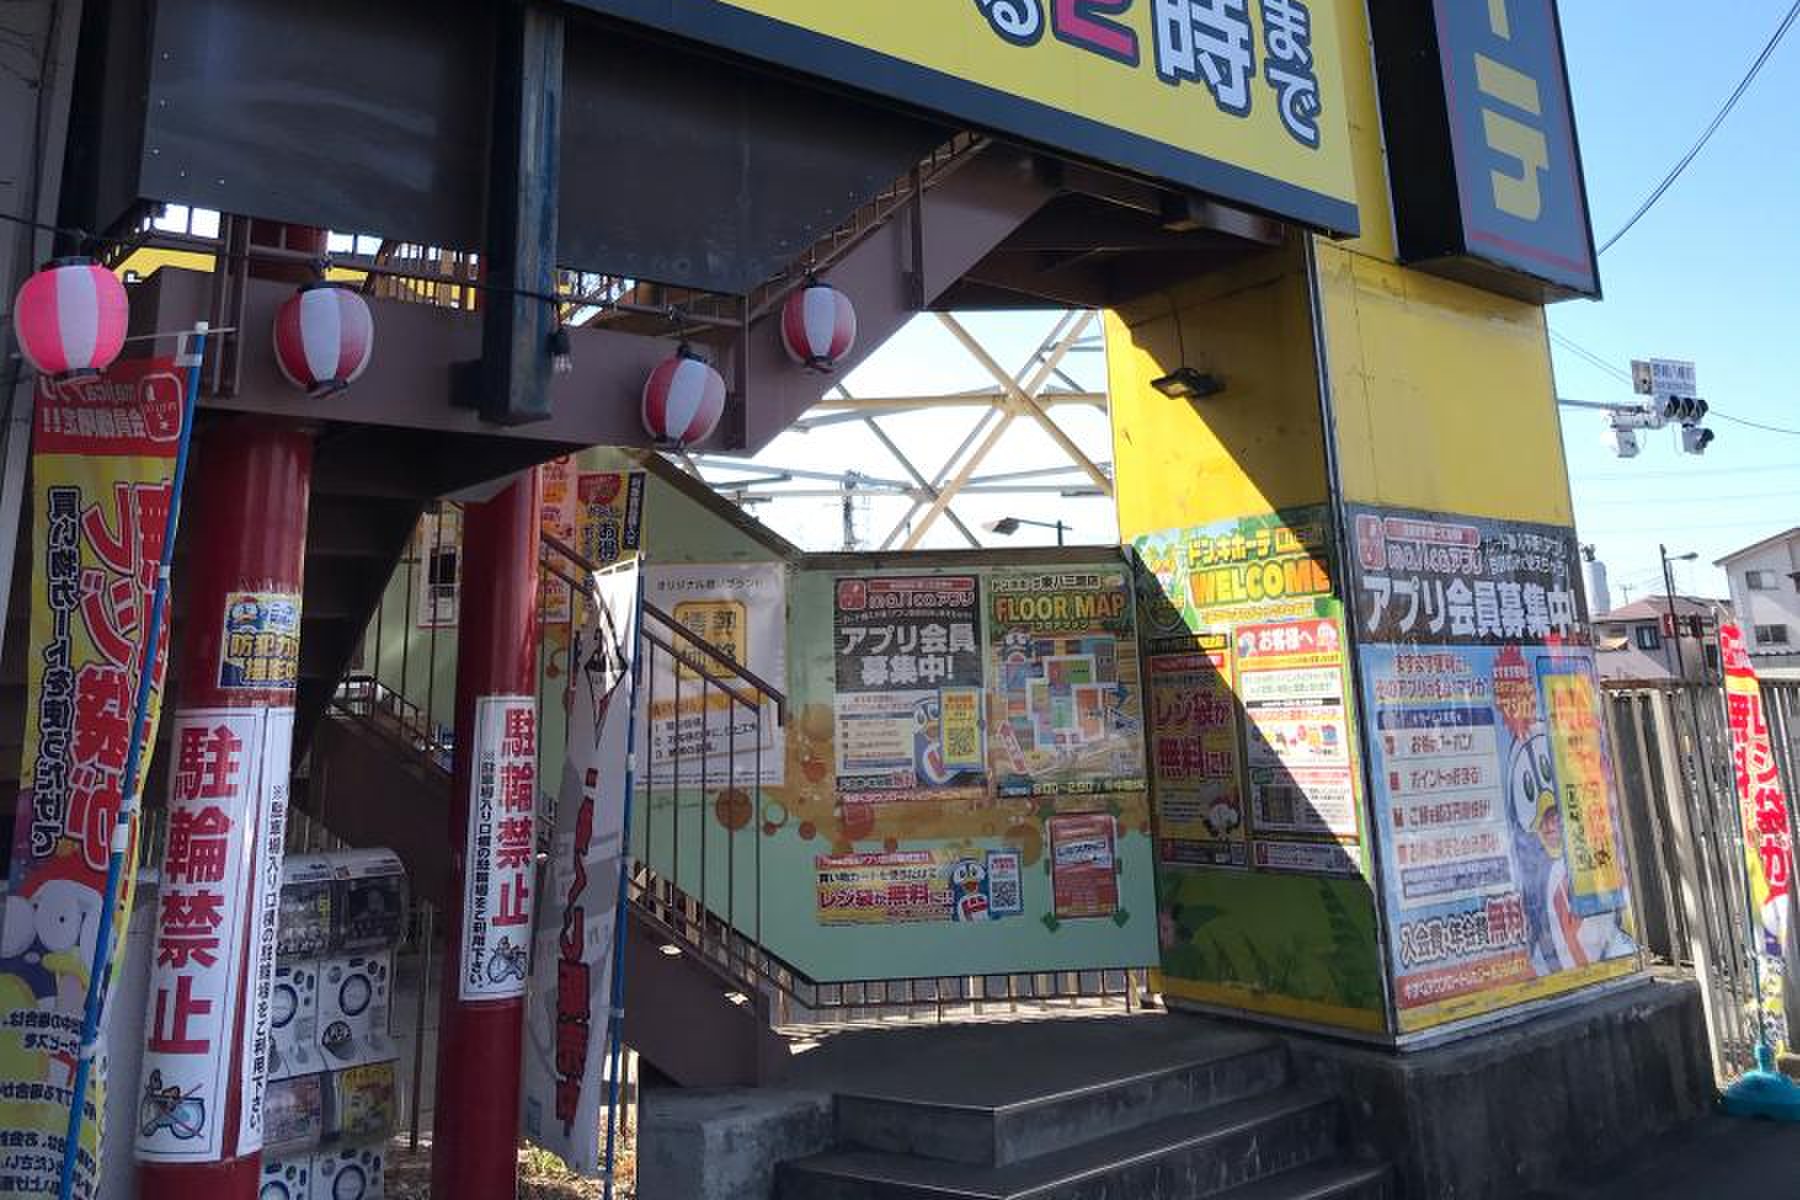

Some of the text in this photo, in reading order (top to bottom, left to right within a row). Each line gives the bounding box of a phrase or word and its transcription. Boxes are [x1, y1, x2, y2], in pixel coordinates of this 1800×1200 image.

[995, 596, 1068, 623] FLOOR
[1075, 593, 1125, 619] MAP
[1189, 560, 1331, 608] WELCOME
[840, 623, 977, 654] アプリ会員
[491, 707, 537, 927] 駐輪禁止
[148, 724, 243, 1056] 駐輪禁止
